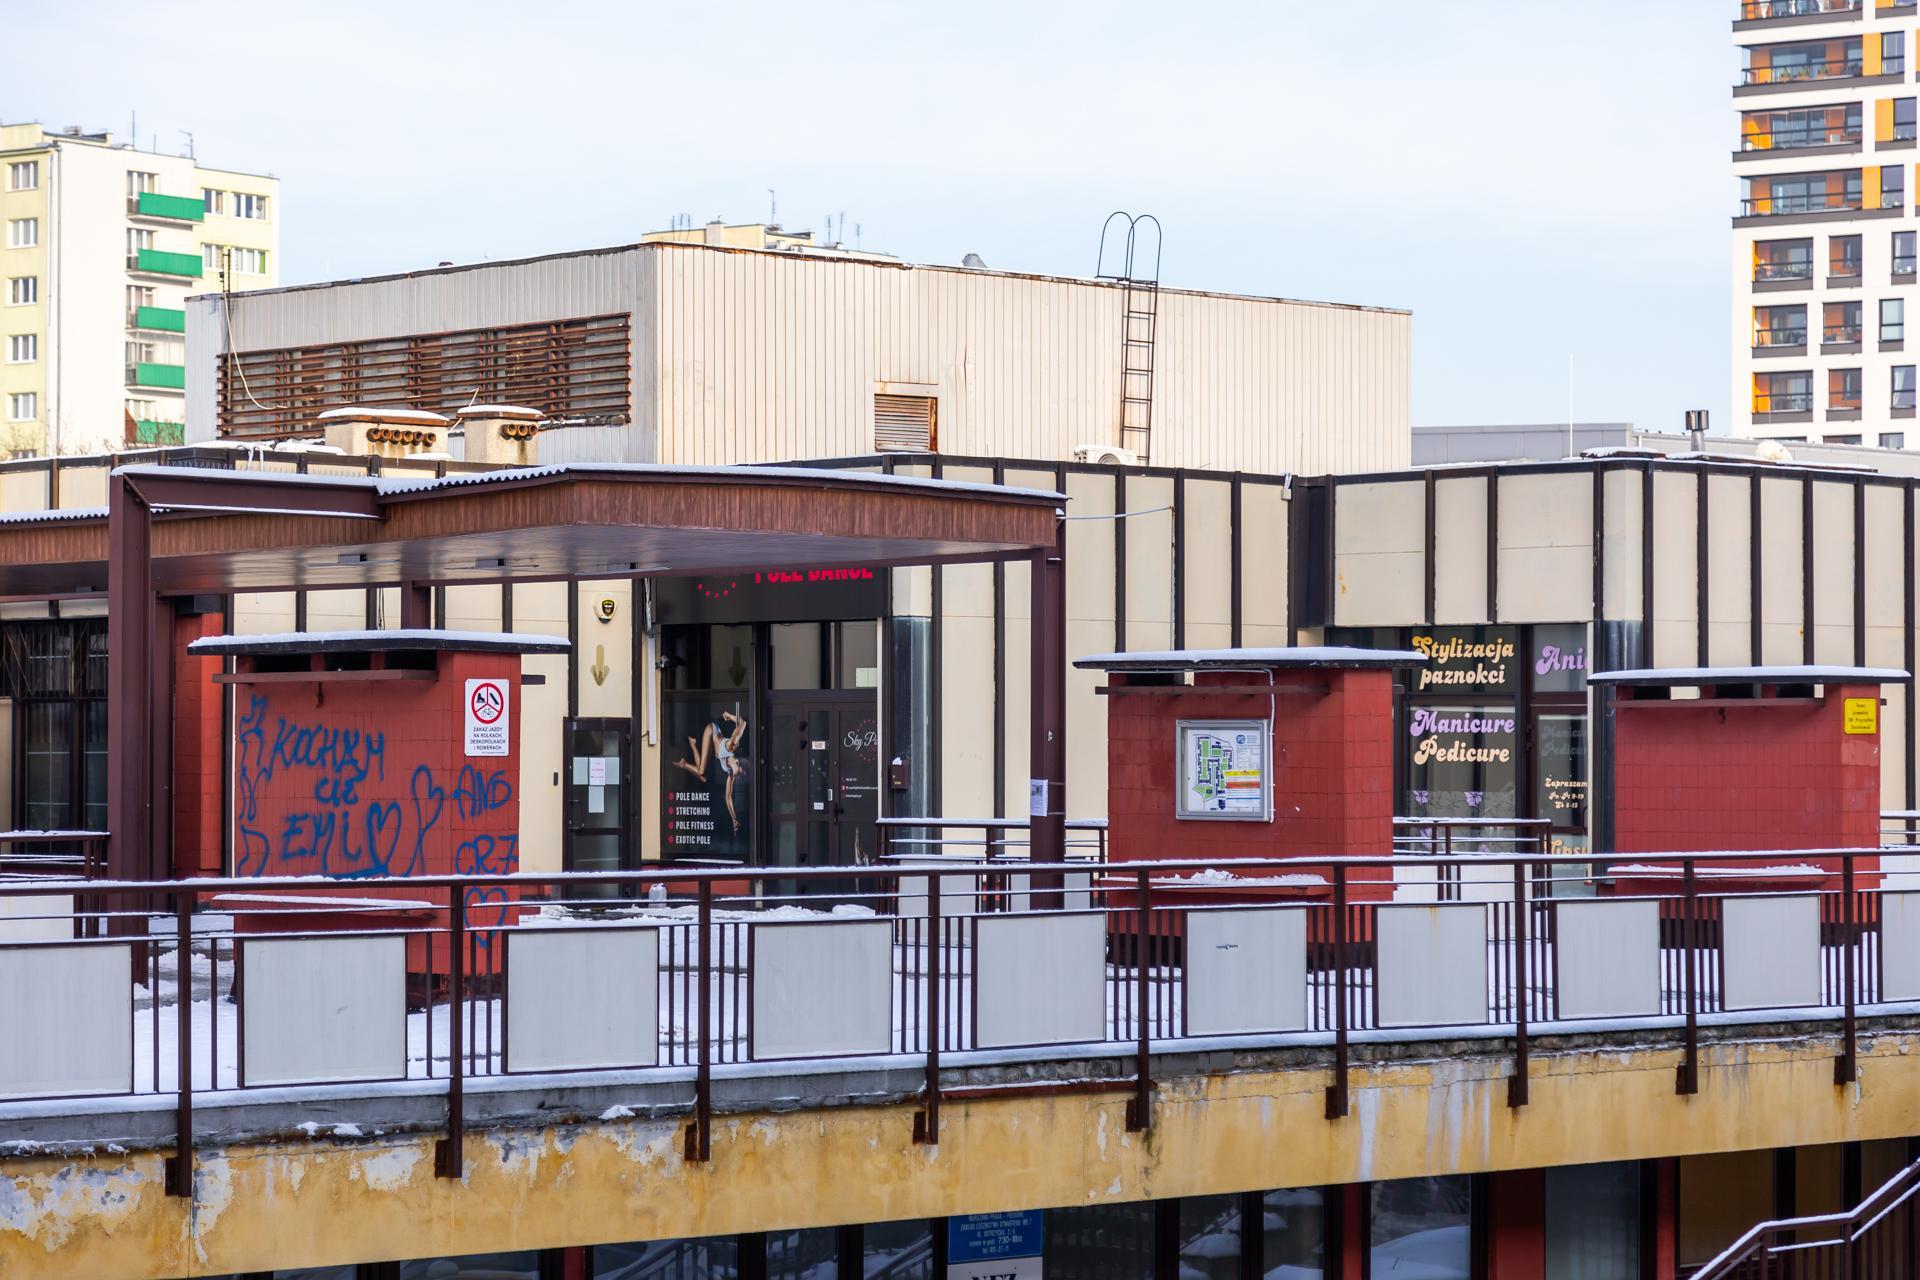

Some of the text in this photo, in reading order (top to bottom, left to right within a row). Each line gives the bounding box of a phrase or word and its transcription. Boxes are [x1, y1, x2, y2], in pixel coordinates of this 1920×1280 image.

[1412, 636, 1514, 664] Stylizacja
[1536, 645, 1588, 675] Ani
[1419, 663, 1505, 690] paznokci
[1410, 708, 1515, 737] Manicure
[844, 731, 863, 751] Sky
[1414, 735, 1510, 765] Pedicure
[676, 792, 710, 801] POLE DANCE
[676, 807, 711, 815] STRETCHING
[676, 821, 714, 830] POLE FITNESS
[676, 835, 711, 844] EXOTIC POLE
